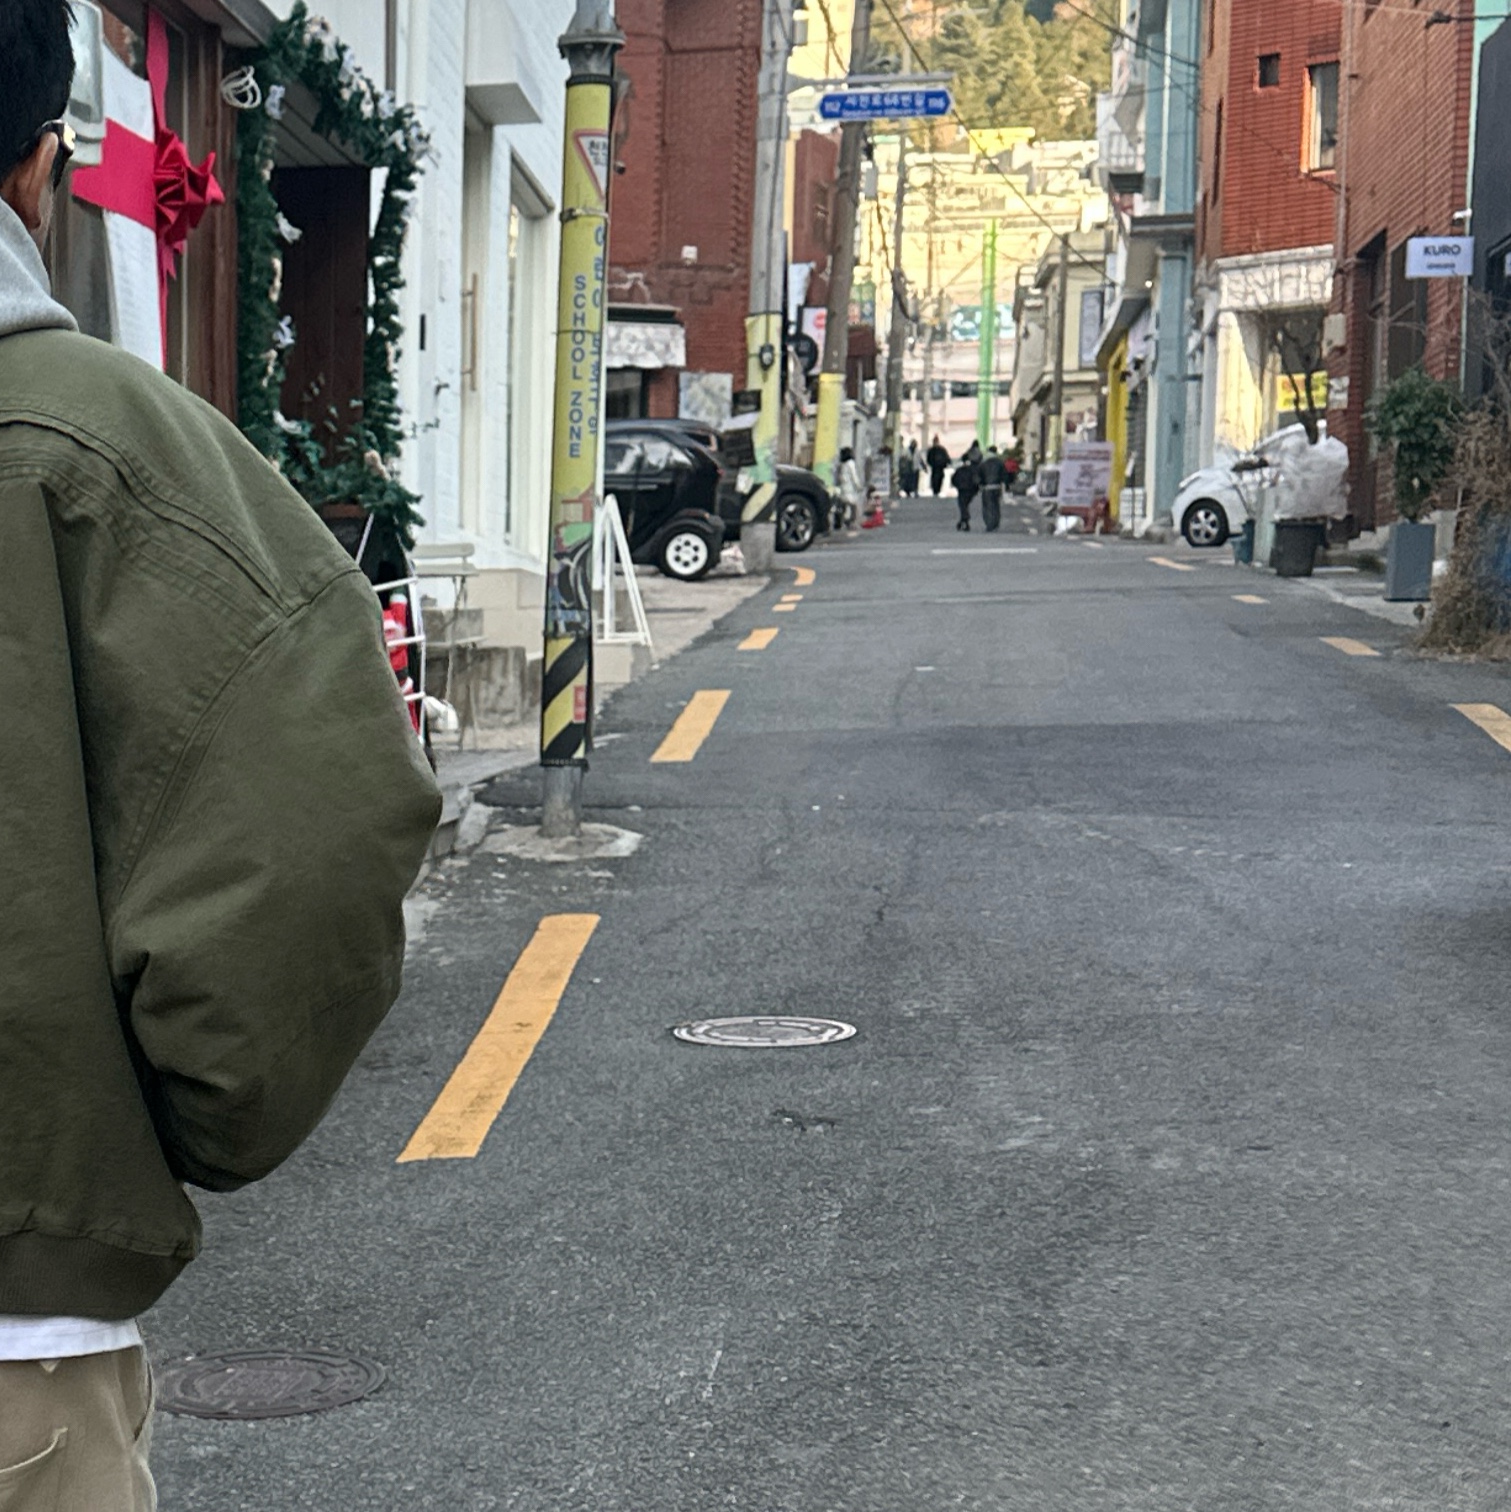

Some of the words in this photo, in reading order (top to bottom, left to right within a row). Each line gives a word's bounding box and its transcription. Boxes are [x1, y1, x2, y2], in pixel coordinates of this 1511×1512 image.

[1423, 244, 1461, 256] KURO
[571, 274, 586, 380] SCHOOL
[569, 391, 583, 459] ZONE
